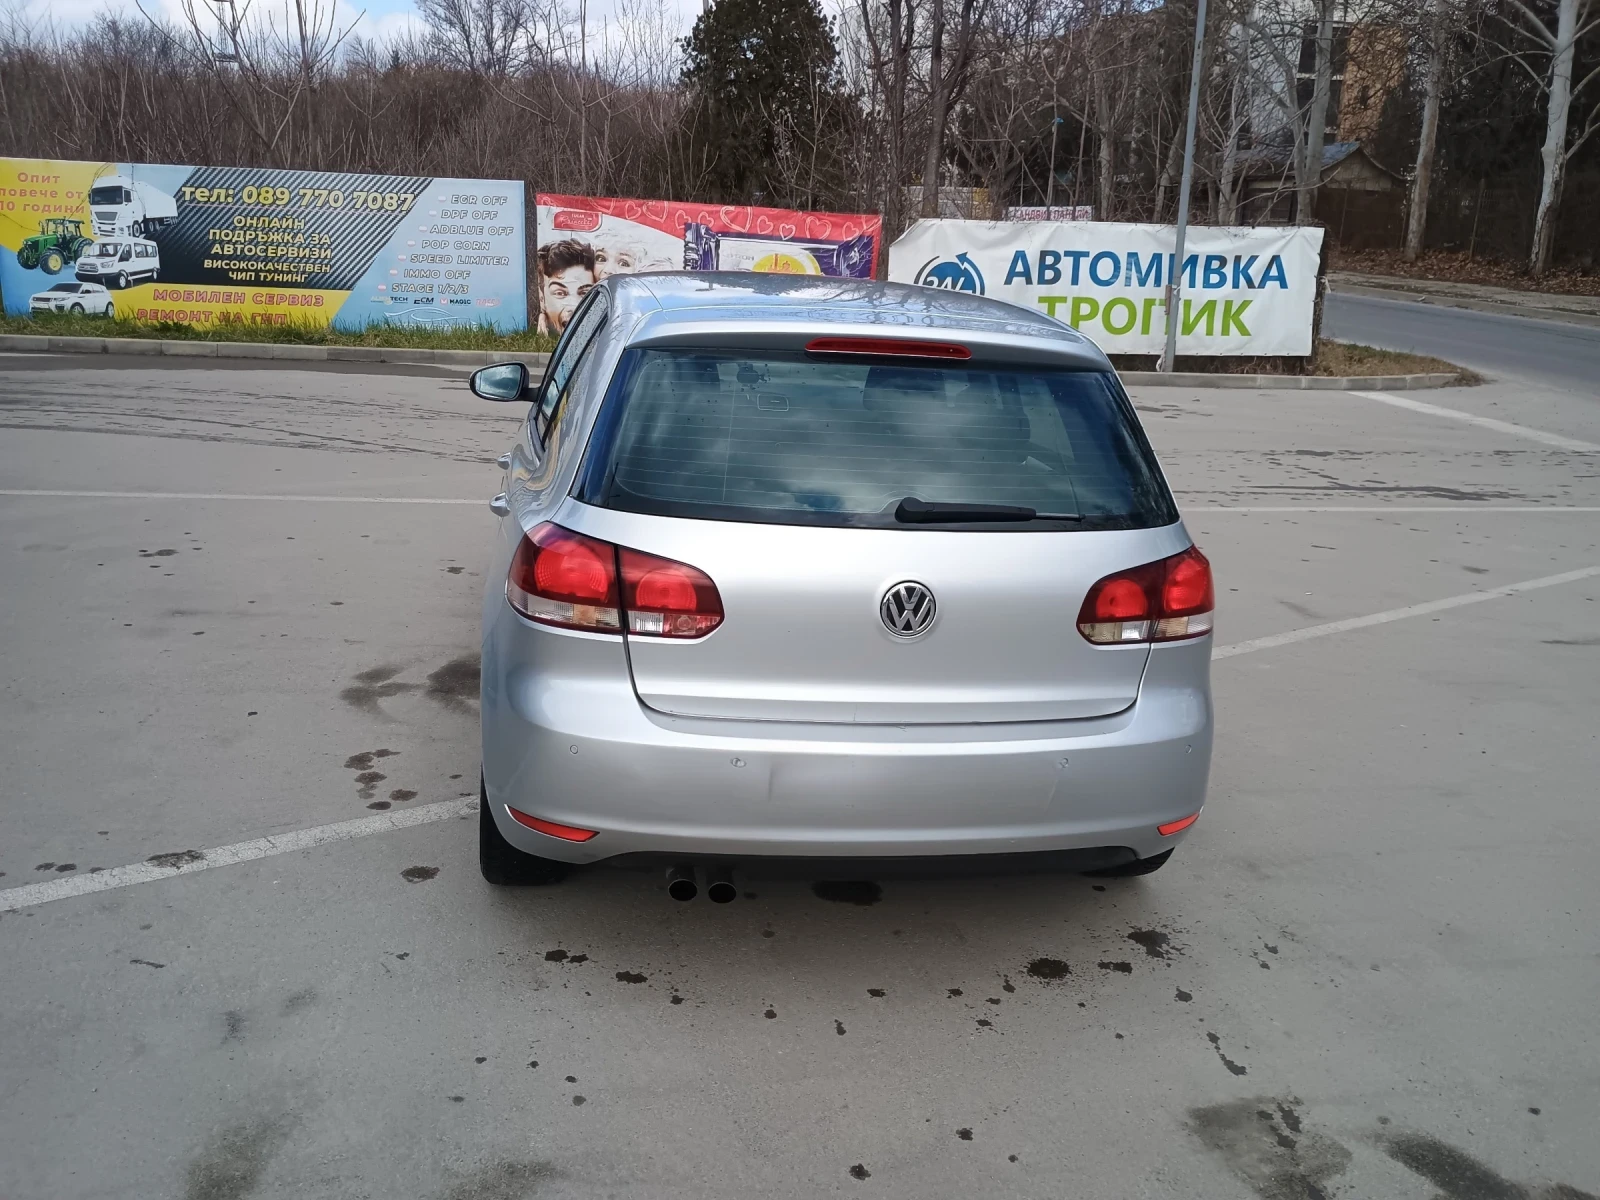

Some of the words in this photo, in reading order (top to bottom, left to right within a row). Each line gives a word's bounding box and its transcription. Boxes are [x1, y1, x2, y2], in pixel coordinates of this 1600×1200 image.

[17, 172, 60, 184] Опит
[0, 188, 58, 199] повече
[65, 190, 83, 199] от
[182, 186, 235, 203] тел:
[242, 185, 290, 205] 089
[300, 188, 345, 208] 770
[352, 190, 415, 211] 7087
[0, 200, 15, 211] 10
[23, 203, 85, 214] години
[451, 195, 477, 205] EGR
[481, 195, 508, 206] OFF
[441, 209, 468, 219] DPF
[472, 210, 498, 220] OFF
[233, 215, 305, 230] ОНЛАЙН
[430, 224, 484, 235] ADBLUE
[488, 226, 514, 236] OFF
[208, 229, 305, 244] ПОДРЪЖКА
[310, 233, 331, 245] ЗА
[210, 243, 332, 259] АВТОСЕРВИЗИ
[422, 240, 450, 249] POP
[453, 240, 491, 251] CORN
[203, 259, 331, 273] ВИСОКОКАЧЕСТВЕН
[410, 254, 453, 264] SPEED
[457, 255, 509, 265] LIMITER
[404, 269, 440, 279] IMMO
[445, 269, 471, 280] OFF
[1004, 249, 1289, 290] АВТОМИВКА
[228, 271, 255, 281] ЧИП
[258, 272, 309, 283] ТУНИНГ
[392, 283, 434, 293] STAGE
[437, 284, 469, 295] 1/2/3
[153, 289, 246, 304] МОБИЛЕН
[252, 292, 325, 307] СЕРВИЗ
[137, 308, 213, 323] РЕМОНТ
[1038, 296, 1253, 337] ТРОПИК
